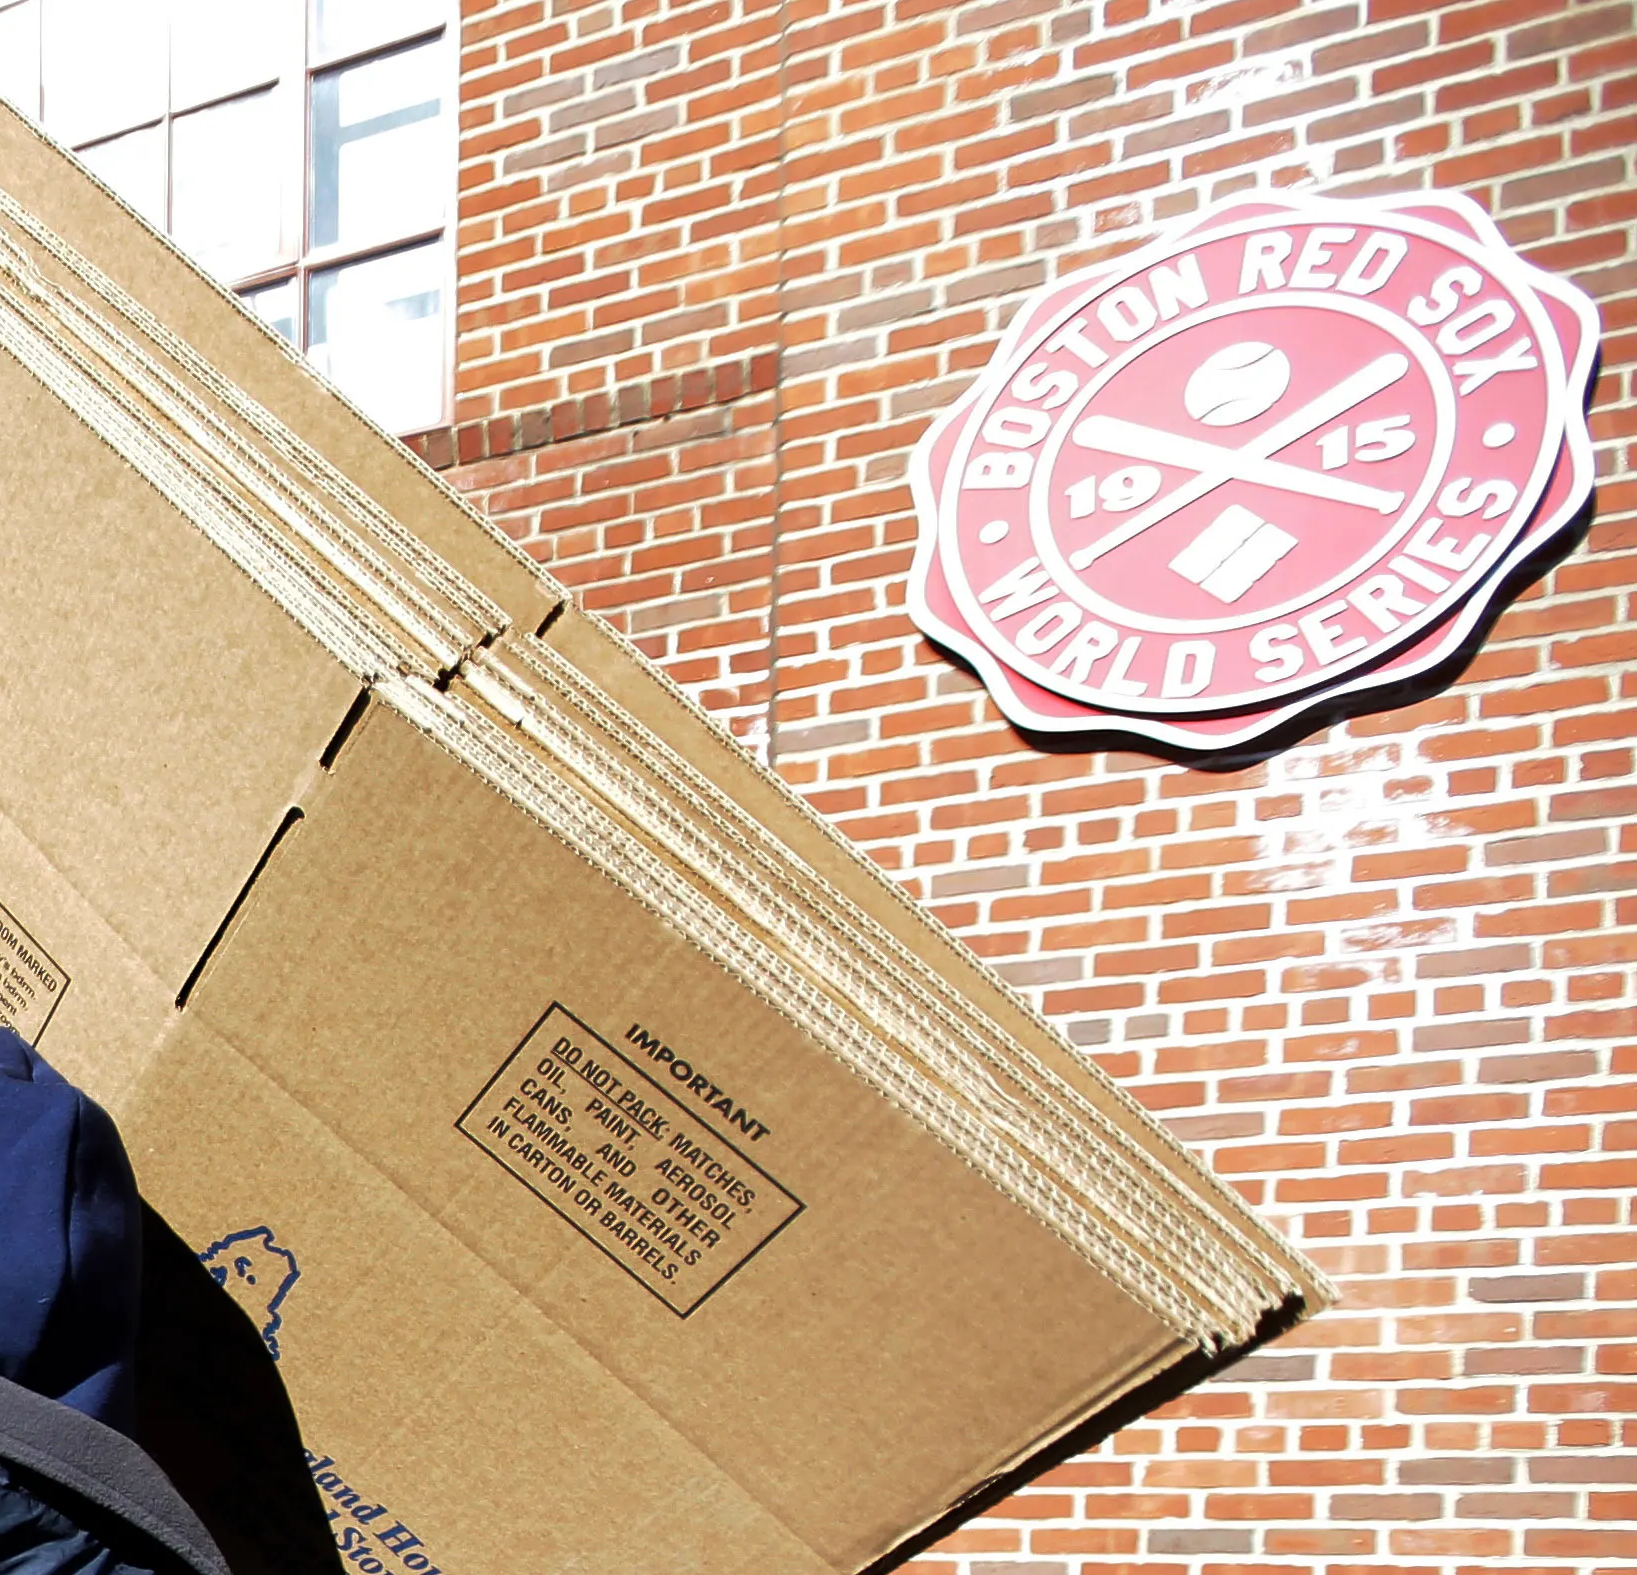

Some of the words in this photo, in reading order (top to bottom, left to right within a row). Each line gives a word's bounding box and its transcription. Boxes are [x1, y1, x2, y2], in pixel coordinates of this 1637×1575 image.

[963, 254, 1209, 490] BOSTON
[1238, 226, 1408, 296] RED
[1407, 266, 1537, 396] SOX
[1064, 465, 1163, 520] 19
[1316, 415, 1417, 470] 15
[979, 557, 1215, 699] WORLD
[1249, 476, 1518, 684] SERIES
[16, 944, 58, 993] MARKED
[519, 1077, 574, 1133] CANS,
[595, 1142, 638, 1179] AND
[651, 1187, 722, 1250] OTHER
[535, 1057, 568, 1094] OIL,
[585, 1098, 643, 1151] PAINT,
[654, 1157, 736, 1230] AEROSOL
[551, 1036, 584, 1066] DO
[580, 1057, 623, 1094] NOT
[668, 1133, 756, 1214] MATCHES,
[624, 1023, 771, 1142] IMPORTANT
[487, 1116, 512, 1141] IN
[508, 1132, 577, 1194] CARTON
[573, 1188, 605, 1218] OR
[599, 1212, 680, 1286] BARRELS.
[502, 1097, 609, 1188] FLAMMABLE
[603, 1181, 703, 1268] MATERIALS
[304, 1449, 388, 1524] land
